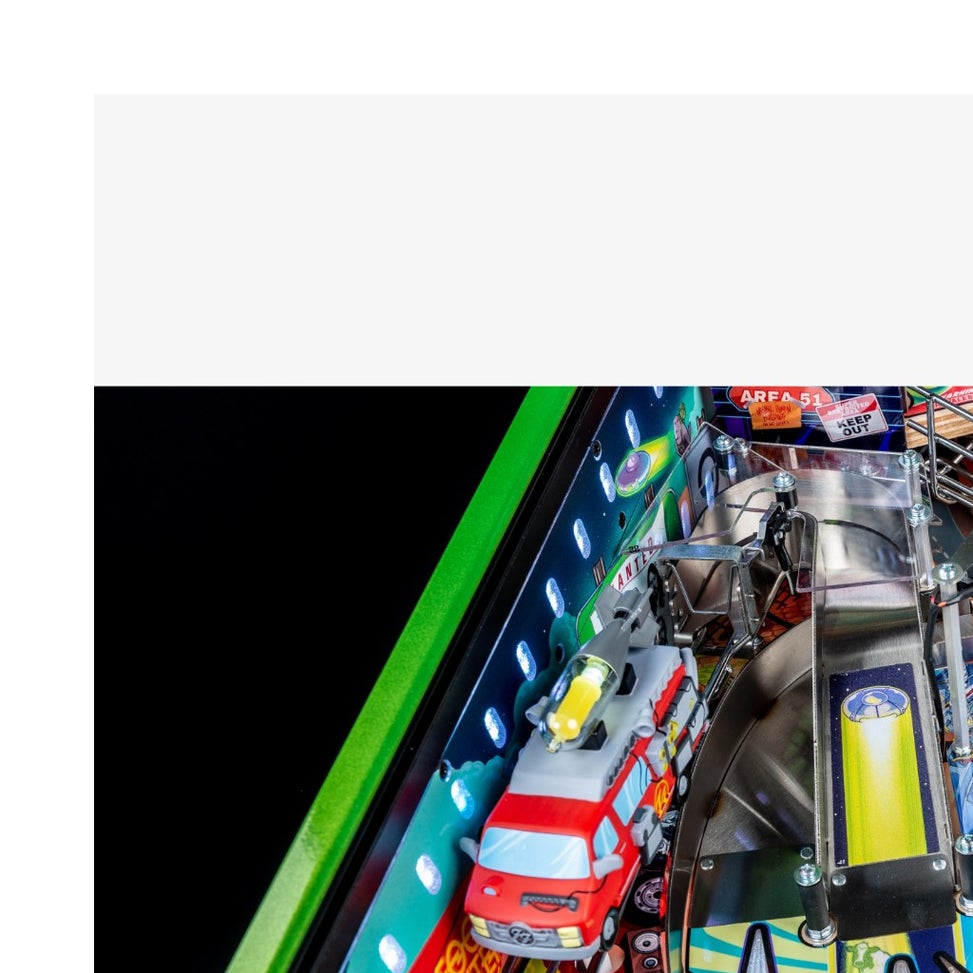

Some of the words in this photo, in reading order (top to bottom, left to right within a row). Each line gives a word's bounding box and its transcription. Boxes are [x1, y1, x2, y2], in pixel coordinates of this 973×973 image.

[801, 392, 823, 407] 51
[837, 413, 872, 429] KEEP
[843, 423, 871, 437] OUT
